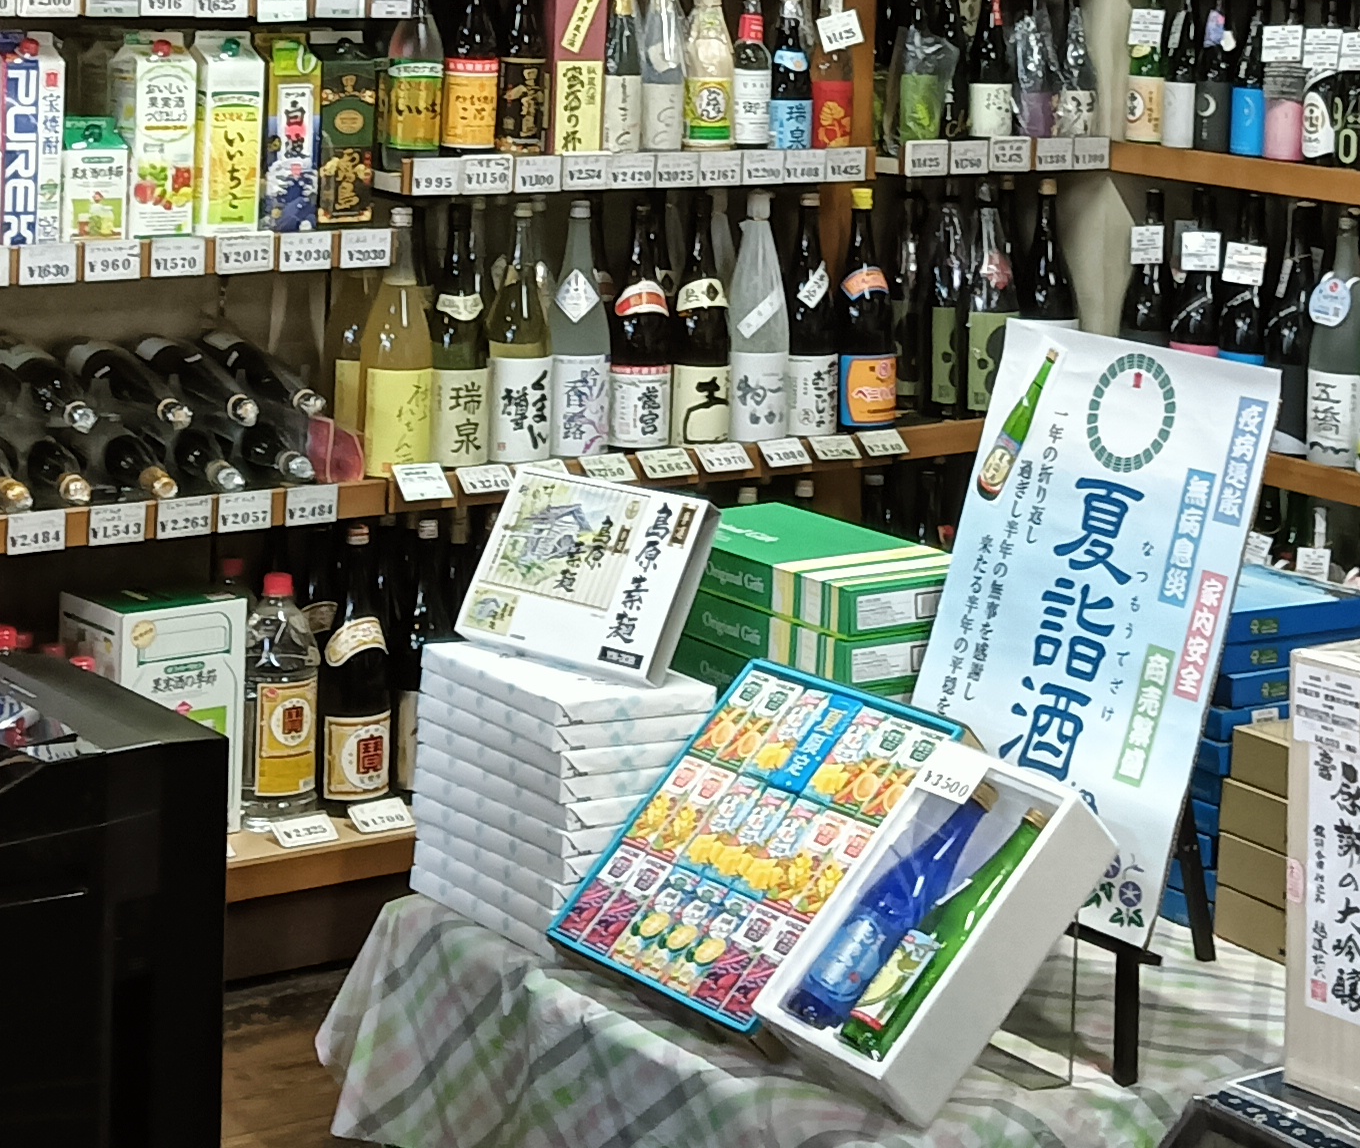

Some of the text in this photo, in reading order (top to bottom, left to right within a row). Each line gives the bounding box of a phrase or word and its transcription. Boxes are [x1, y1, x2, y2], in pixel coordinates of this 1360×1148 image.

[223, 128, 247, 210] いいちこ
[414, 176, 453, 189] ¥995
[88, 258, 132, 273] ¥960
[449, 381, 483, 455] 瑞泉
[998, 476, 1145, 782] 夏詣酒
[1099, 538, 1156, 724] なつもうでざけ
[1175, 575, 1227, 697] 家内安全
